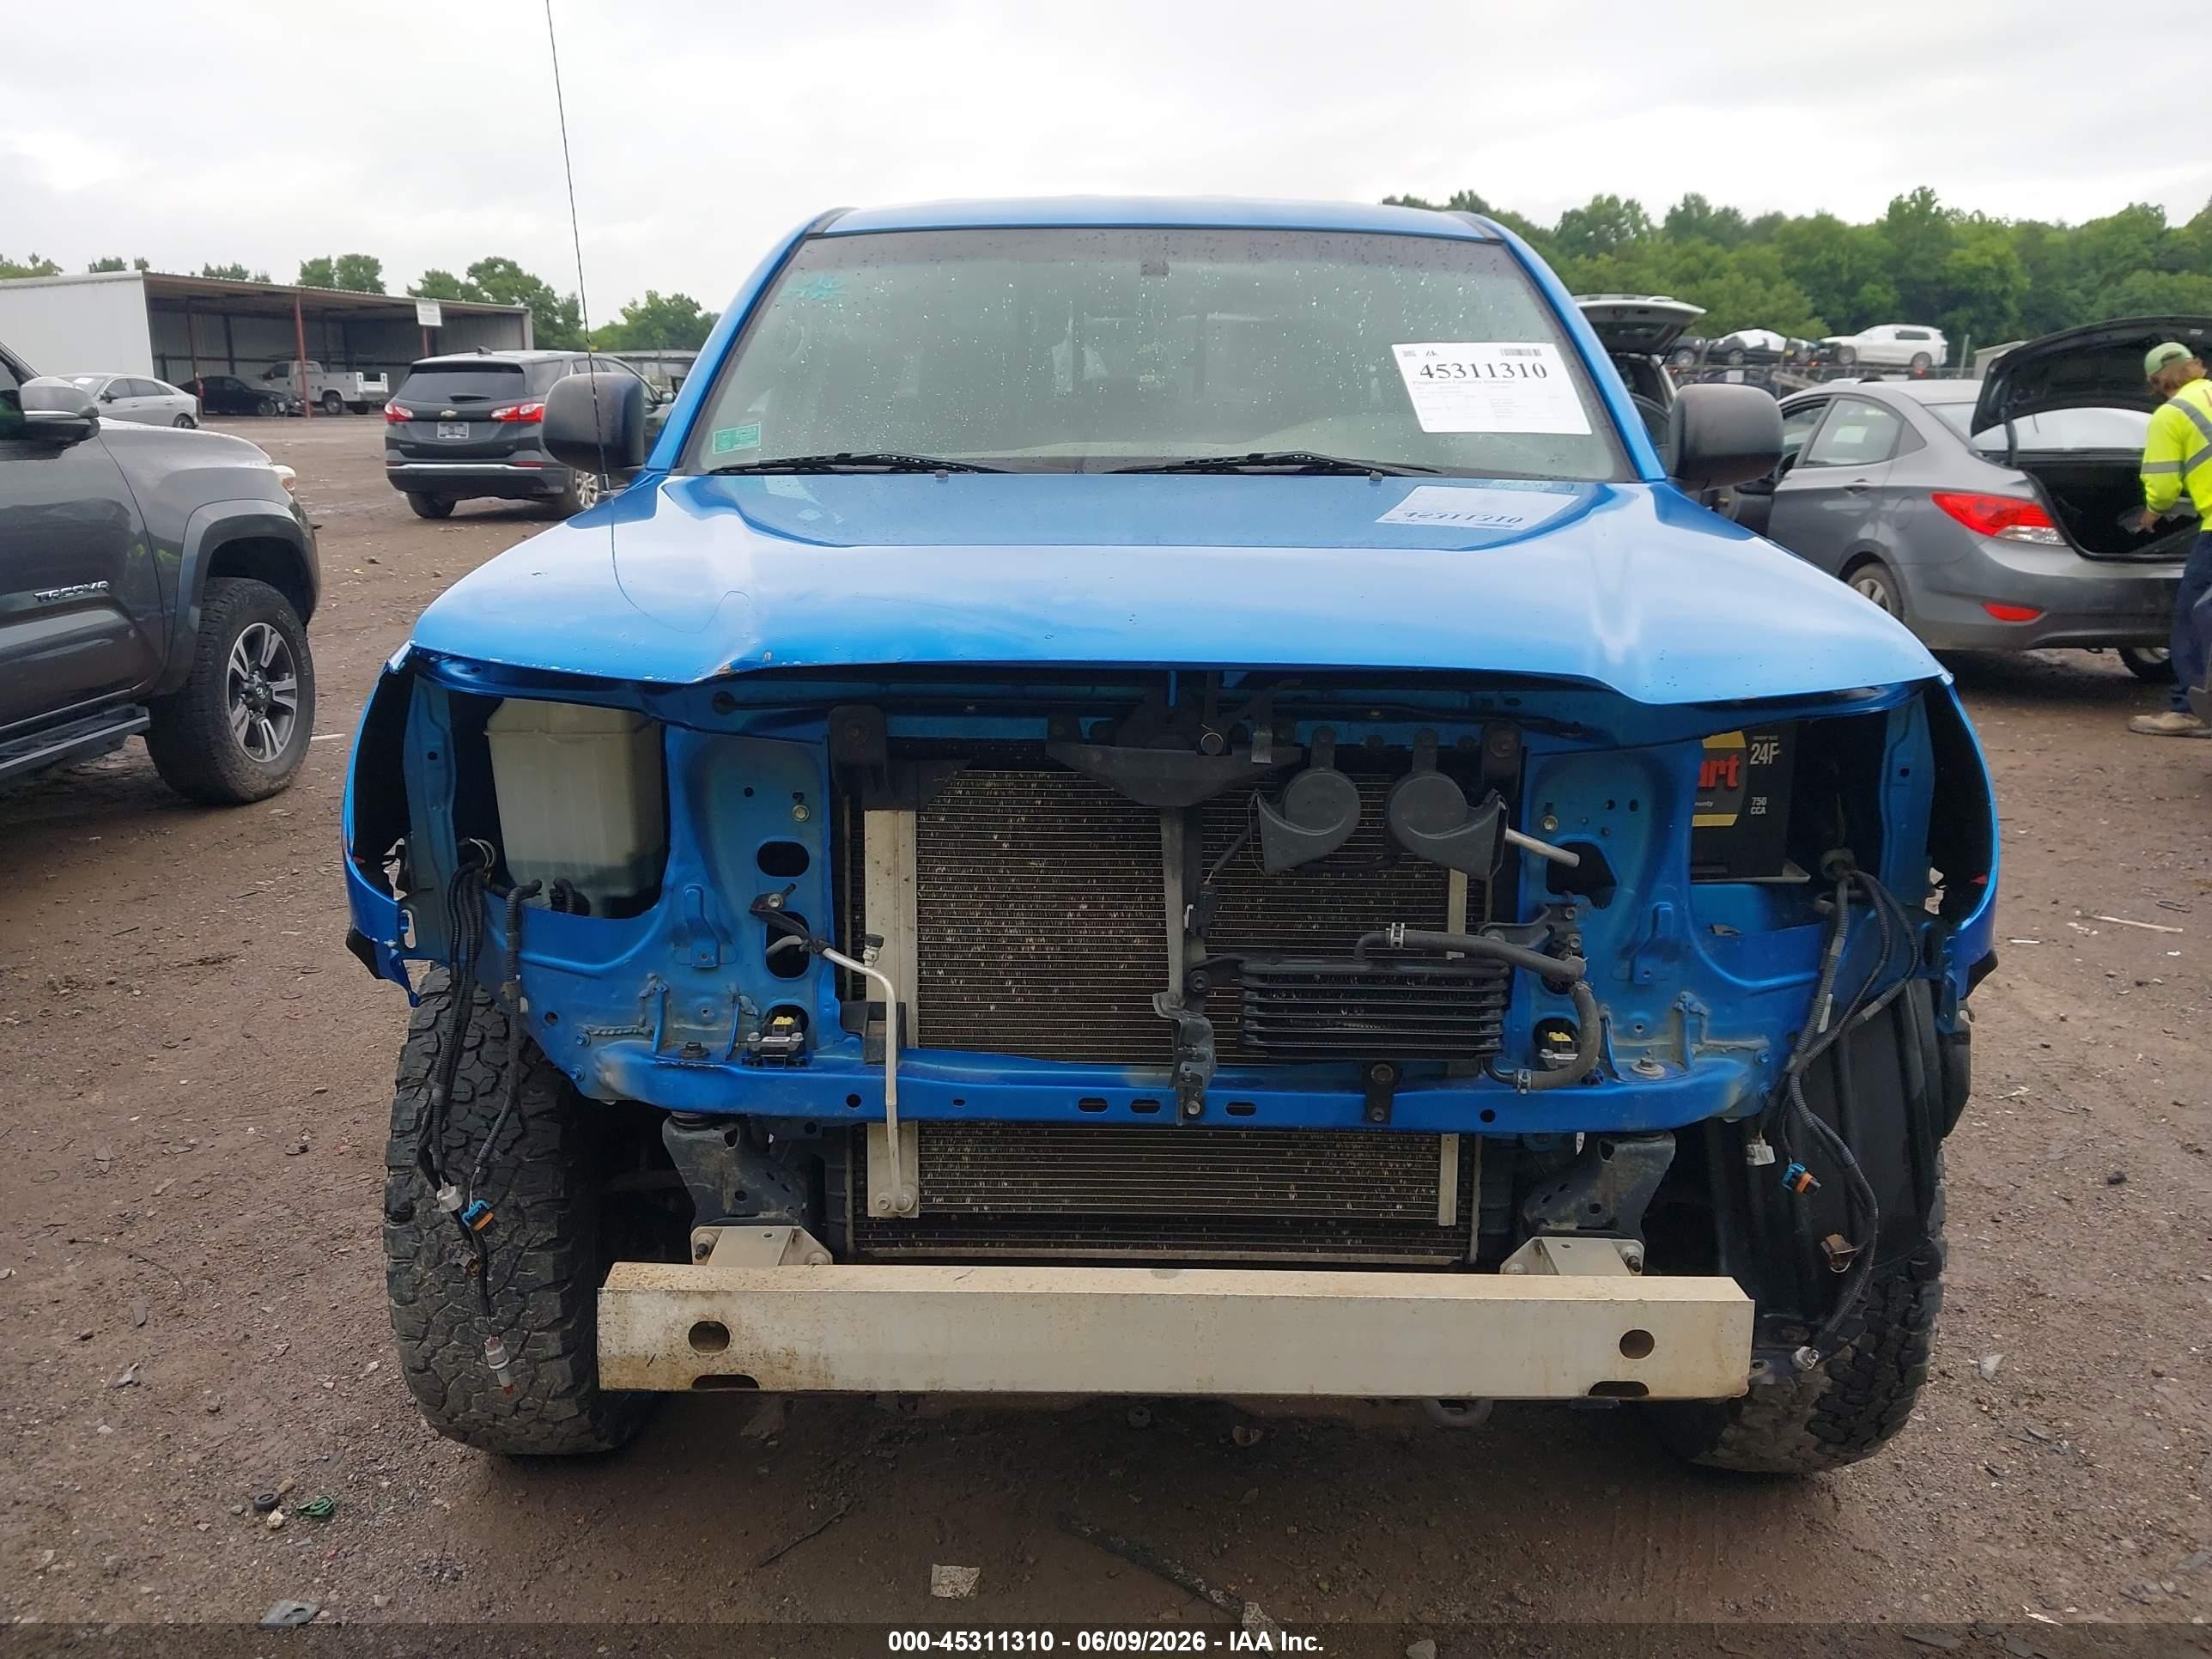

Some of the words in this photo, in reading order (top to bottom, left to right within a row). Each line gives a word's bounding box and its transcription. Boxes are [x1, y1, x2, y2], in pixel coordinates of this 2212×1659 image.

[1419, 362, 1548, 379] 45311310
[1750, 743, 1780, 765] 24F
[1752, 797, 1767, 805] 750
